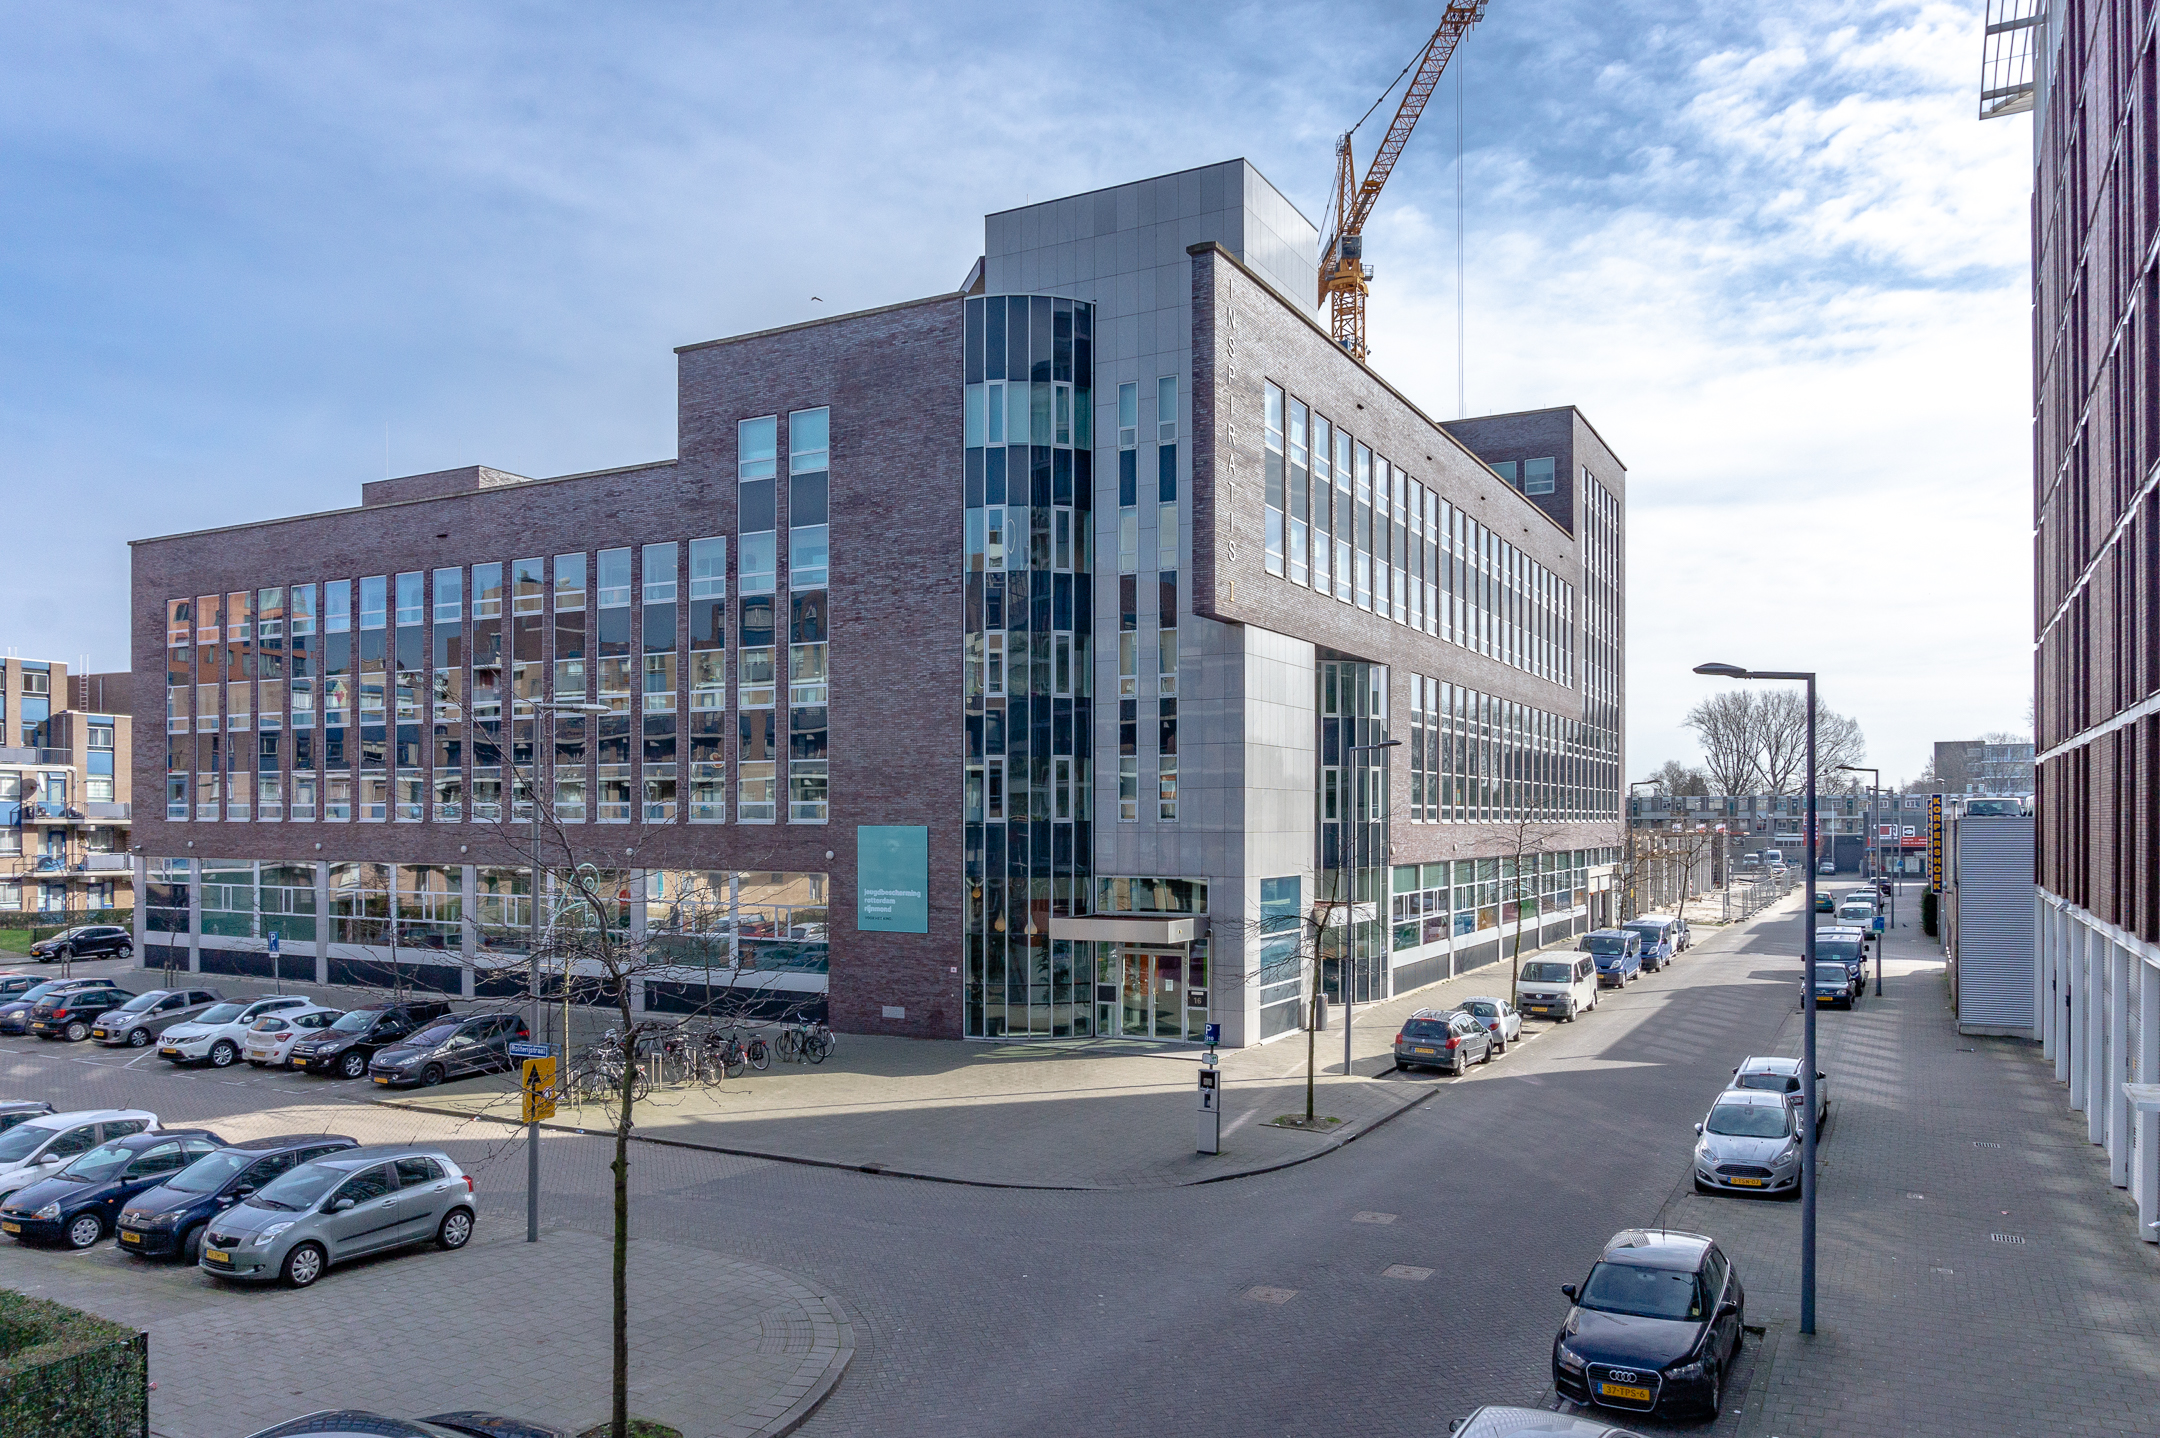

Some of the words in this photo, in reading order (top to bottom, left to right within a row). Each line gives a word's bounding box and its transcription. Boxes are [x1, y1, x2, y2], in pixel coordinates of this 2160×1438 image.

[1226, 277, 1236, 562] INSPIRATIS
[1933, 797, 1942, 890] KORPERSHOEK
[864, 888, 921, 898] jeugdbescherming
[864, 905, 892, 913] rijnmond
[1205, 1024, 1212, 1035] P
[1606, 1385, 1646, 1399] 37-TPS-6
